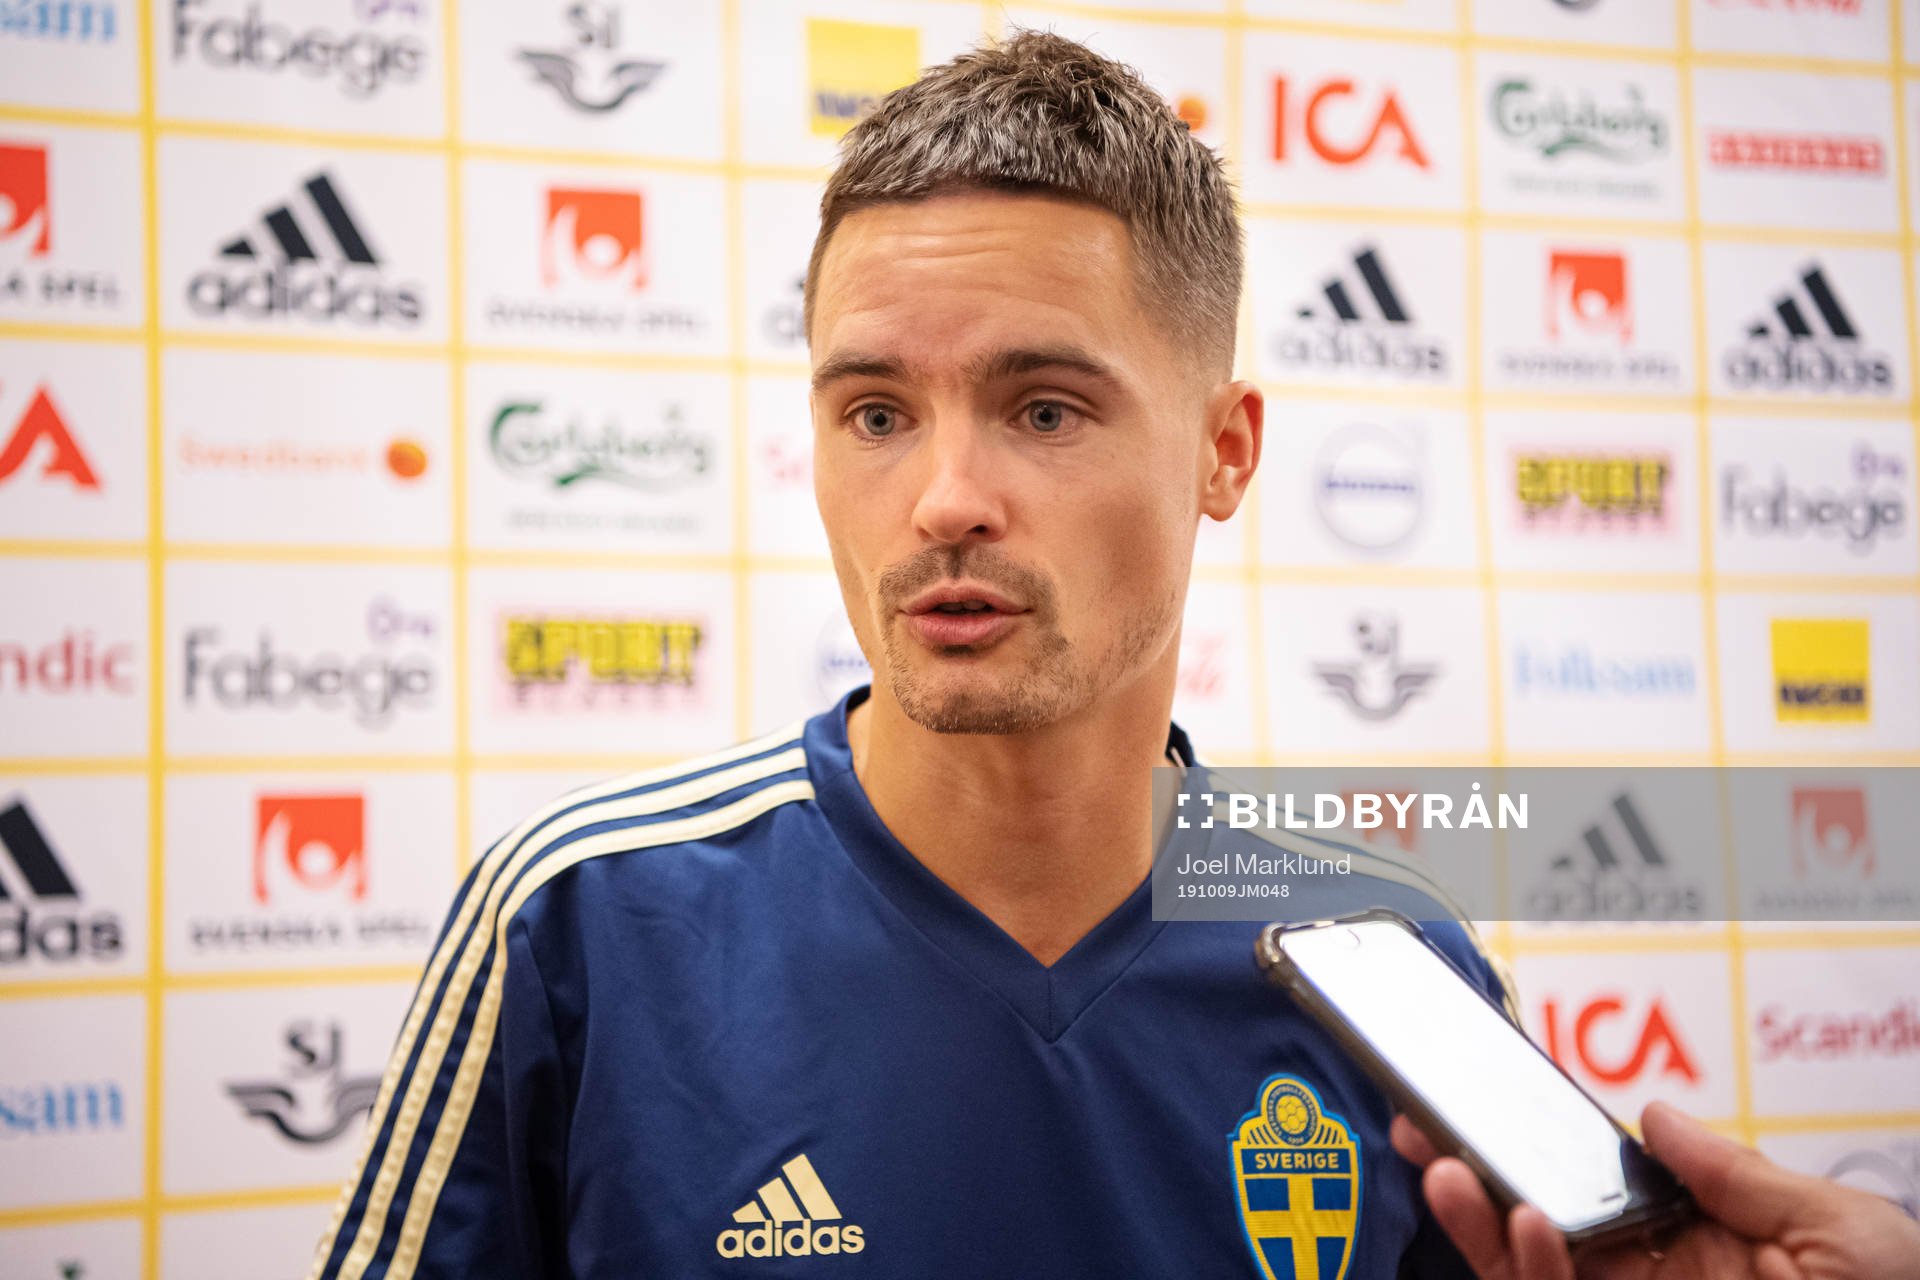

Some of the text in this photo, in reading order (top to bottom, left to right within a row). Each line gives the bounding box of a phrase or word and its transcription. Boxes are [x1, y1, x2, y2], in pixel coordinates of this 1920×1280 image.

[171, 0, 424, 96] Fabege
[1270, 75, 1430, 170] ICA
[187, 258, 421, 320] adidas
[1275, 325, 1444, 374] adidas
[1726, 340, 1893, 390] adidas
[185, 629, 434, 730] Fabege
[1544, 997, 1699, 1085] ICA
[1254, 1152, 1340, 1170] SVERIGE
[716, 1218, 866, 1259] adidas
